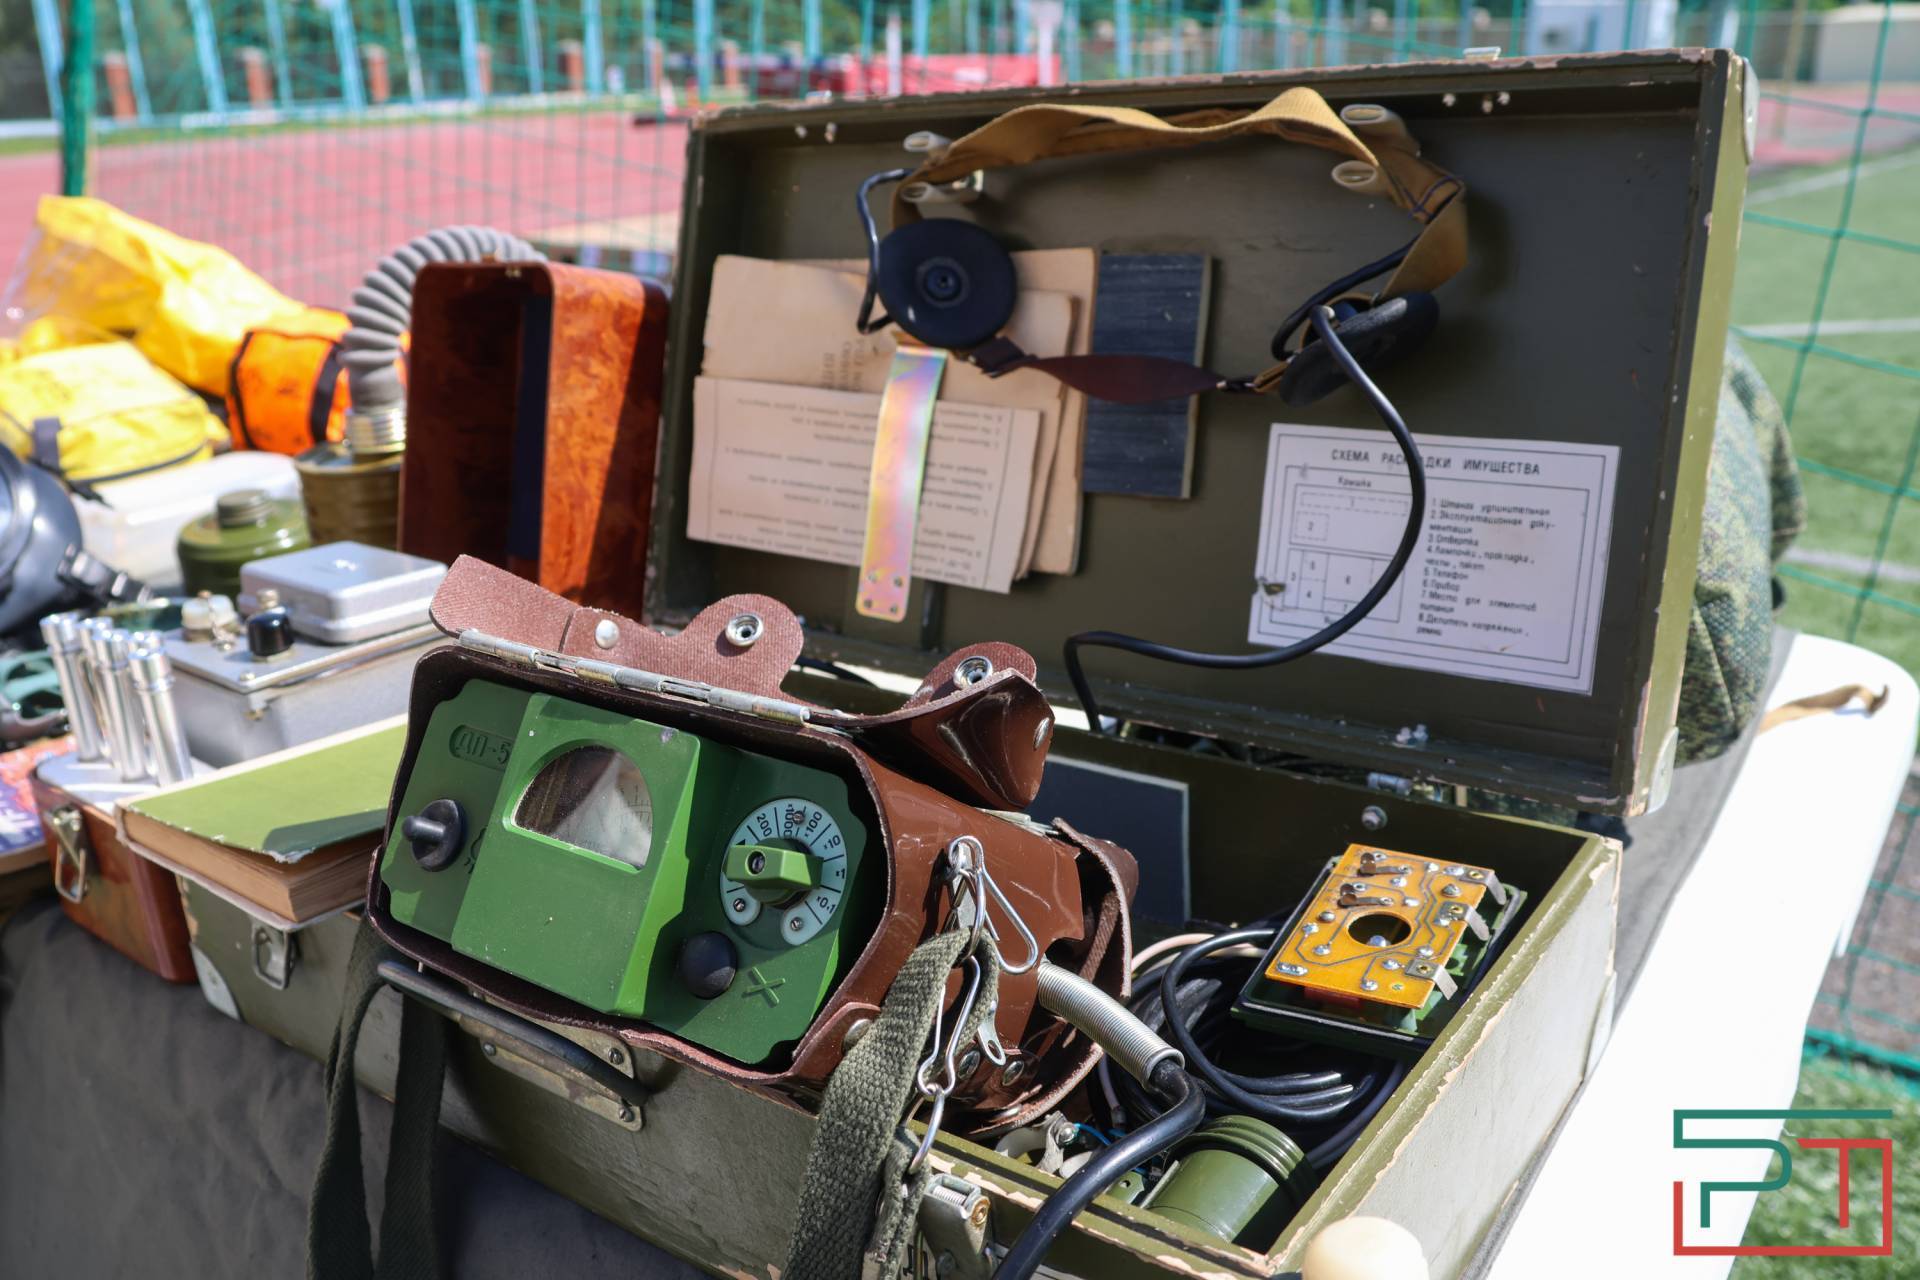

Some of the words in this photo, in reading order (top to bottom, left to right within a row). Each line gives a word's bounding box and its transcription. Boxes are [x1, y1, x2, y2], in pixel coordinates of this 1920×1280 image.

[1331, 449, 1370, 462] СХЕМА
[1463, 458, 1540, 476] ИМУЩЕСТВА
[757, 813, 773, 838] 200
